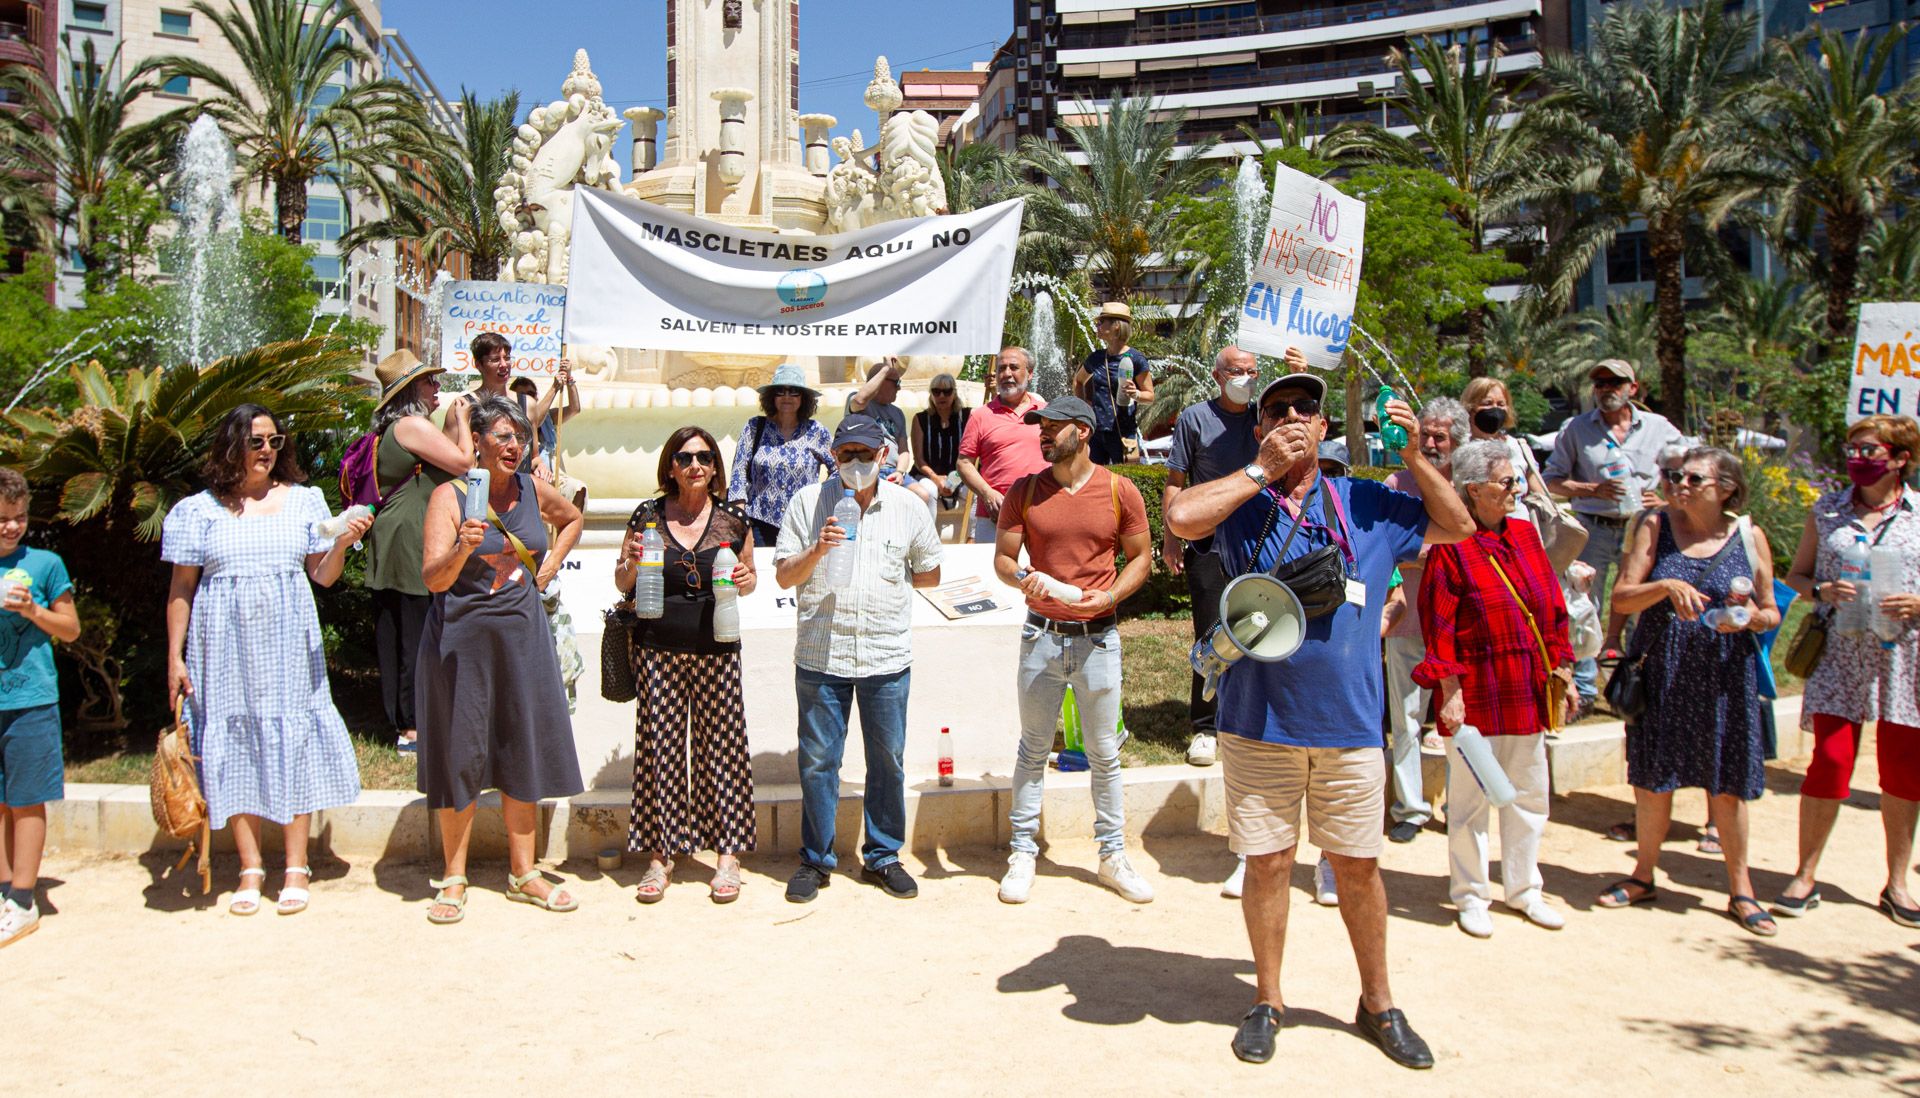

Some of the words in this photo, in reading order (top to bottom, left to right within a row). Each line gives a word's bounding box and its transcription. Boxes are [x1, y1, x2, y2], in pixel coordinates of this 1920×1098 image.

[1309, 191, 1339, 243] NO
[640, 221, 829, 263] MASCLETAES
[845, 238, 913, 262] AQUI
[931, 226, 972, 249] NO
[1263, 223, 1305, 275] MÁS
[524, 307, 551, 324] el
[779, 305, 796, 315] SOS
[1244, 281, 1282, 327] EN
[659, 316, 737, 336] SALVEM
[743, 322, 767, 337] EL
[771, 322, 849, 337] NOSTRE
[854, 319, 959, 337] PATRIMONI
[1857, 387, 1901, 416] EN
[967, 604, 984, 612] NO
